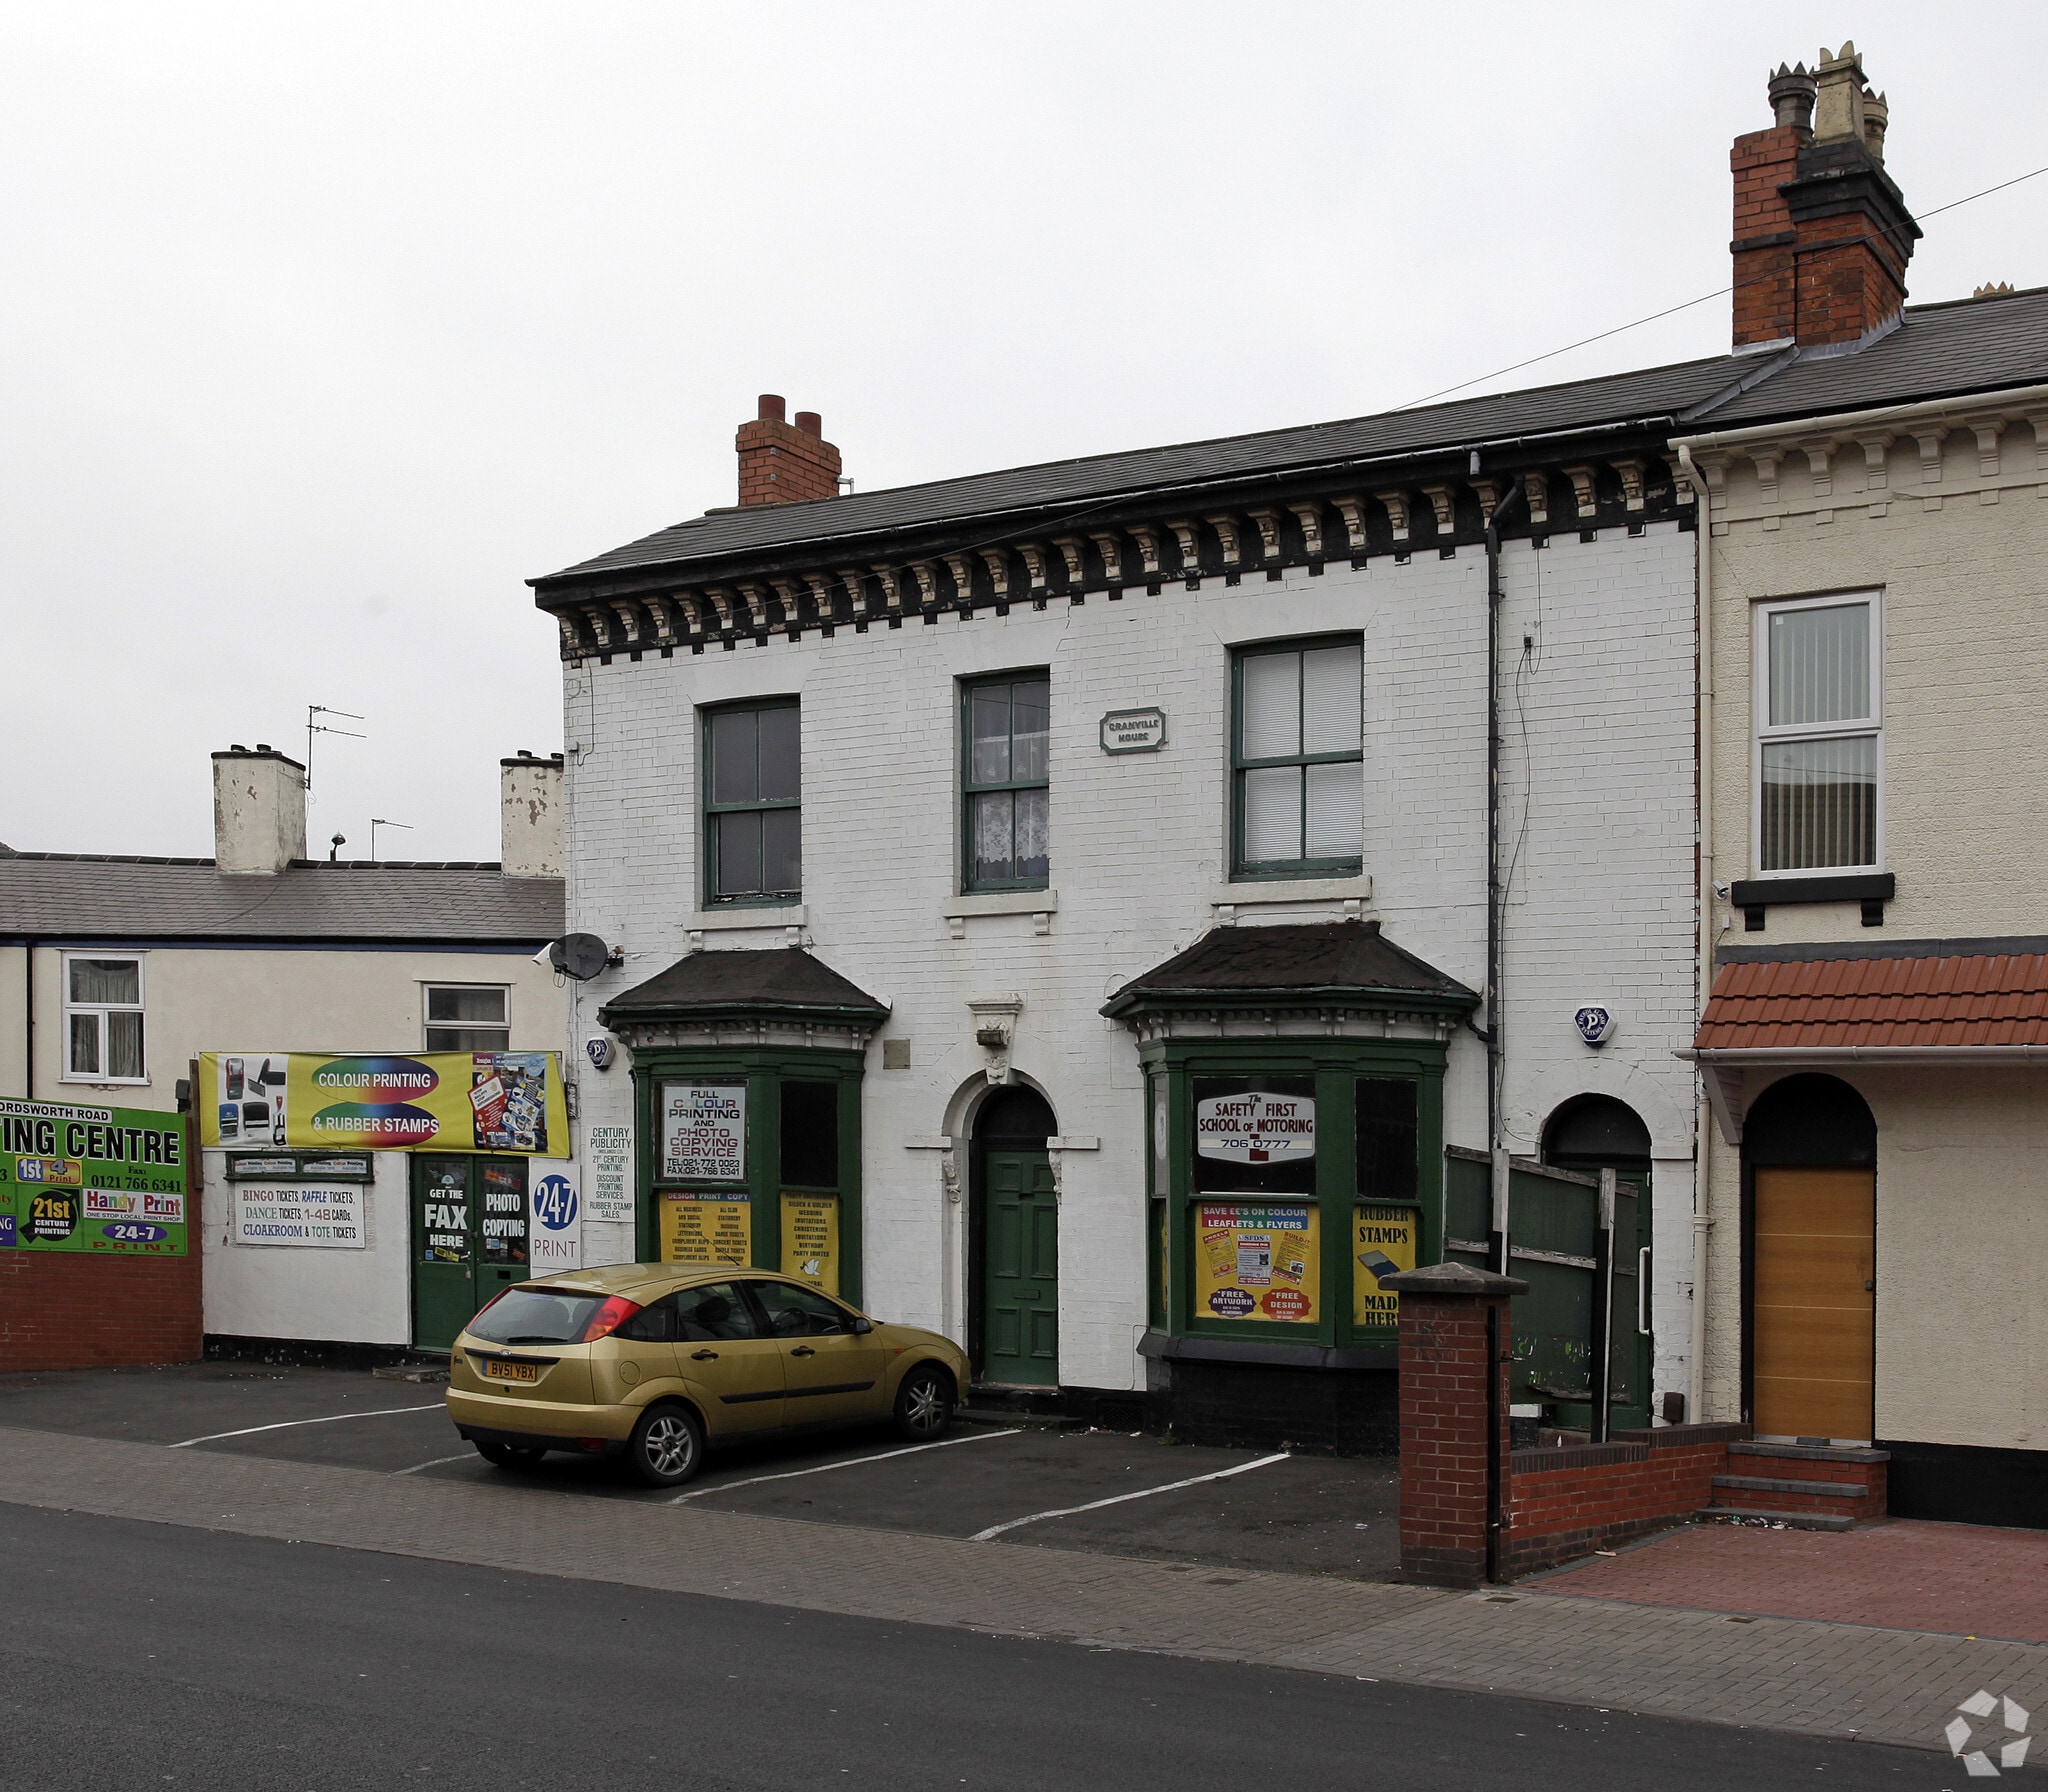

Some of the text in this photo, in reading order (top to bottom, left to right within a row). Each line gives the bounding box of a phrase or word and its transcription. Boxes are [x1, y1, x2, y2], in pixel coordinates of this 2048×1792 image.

[1109, 720, 1159, 732] GRANVILLE
[319, 1073, 431, 1088] COLOUR PRINTING
[691, 1091, 719, 1099] FULL
[1249, 1094, 1262, 1103] The
[674, 1099, 737, 1109] COLOUR
[78, 1110, 109, 1121] ROAD
[669, 1109, 740, 1119] PRINTING
[1215, 1103, 1298, 1117] SAFETY FIRST
[313, 1117, 440, 1133] & RUBBER STAMPS
[1200, 1119, 1241, 1132] SCHOOL
[1257, 1119, 1313, 1133] MOTORING
[593, 1128, 630, 1138] CENTURY
[678, 1128, 730, 1137] PHOTO
[66, 1121, 180, 1166] CENTRE
[591, 1139, 632, 1149] PUBLICITY
[670, 1138, 738, 1148] COPYING
[1221, 1140, 1291, 1149] 706 0777
[672, 1147, 737, 1157] SERVICE
[604, 1156, 629, 1164] CENTURY
[719, 1160, 740, 1168] 0023
[20, 1159, 68, 1179] 1st 4
[720, 1168, 740, 1176] 6341
[91, 1175, 181, 1192] 0121 766 6341
[597, 1175, 624, 1183] DISCOUNT
[598, 1183, 624, 1191] PRINTING
[243, 1190, 274, 1202] BINGO
[302, 1191, 328, 1203] RAFFLE
[430, 1189, 464, 1200] GET THE
[87, 1191, 181, 1216] Handy Print
[486, 1193, 521, 1212] PHOTO
[590, 1202, 633, 1211] RUBBER STAMP
[33, 1198, 70, 1219] 21st
[246, 1207, 278, 1219] DANCE
[305, 1209, 331, 1220] 1-48
[1204, 1207, 1227, 1215] SAVE
[1252, 1208, 1265, 1216] ON
[1268, 1209, 1307, 1217] COLOUR
[1360, 1206, 1409, 1222] RUBBER
[424, 1204, 468, 1230] FAX
[35, 1220, 70, 1228] CENTURY
[482, 1219, 525, 1237] COPYING
[1208, 1220, 1303, 1229] LEAFLETS & FLYERS
[115, 1225, 156, 1240] 24-7
[244, 1224, 357, 1239] CLOAKROOM & TOTE TICKETS
[1360, 1227, 1408, 1244] STAMPS
[430, 1234, 464, 1248] HERE
[93, 1242, 178, 1252] PRINT
[534, 1239, 577, 1258] PRINT
[1212, 1298, 1253, 1306] ARTWORK
[1270, 1301, 1303, 1309] DESIGN
[1365, 1296, 1398, 1310] MAD
[1366, 1312, 1399, 1326] HER
[492, 1363, 534, 1379] BV51 YBX
